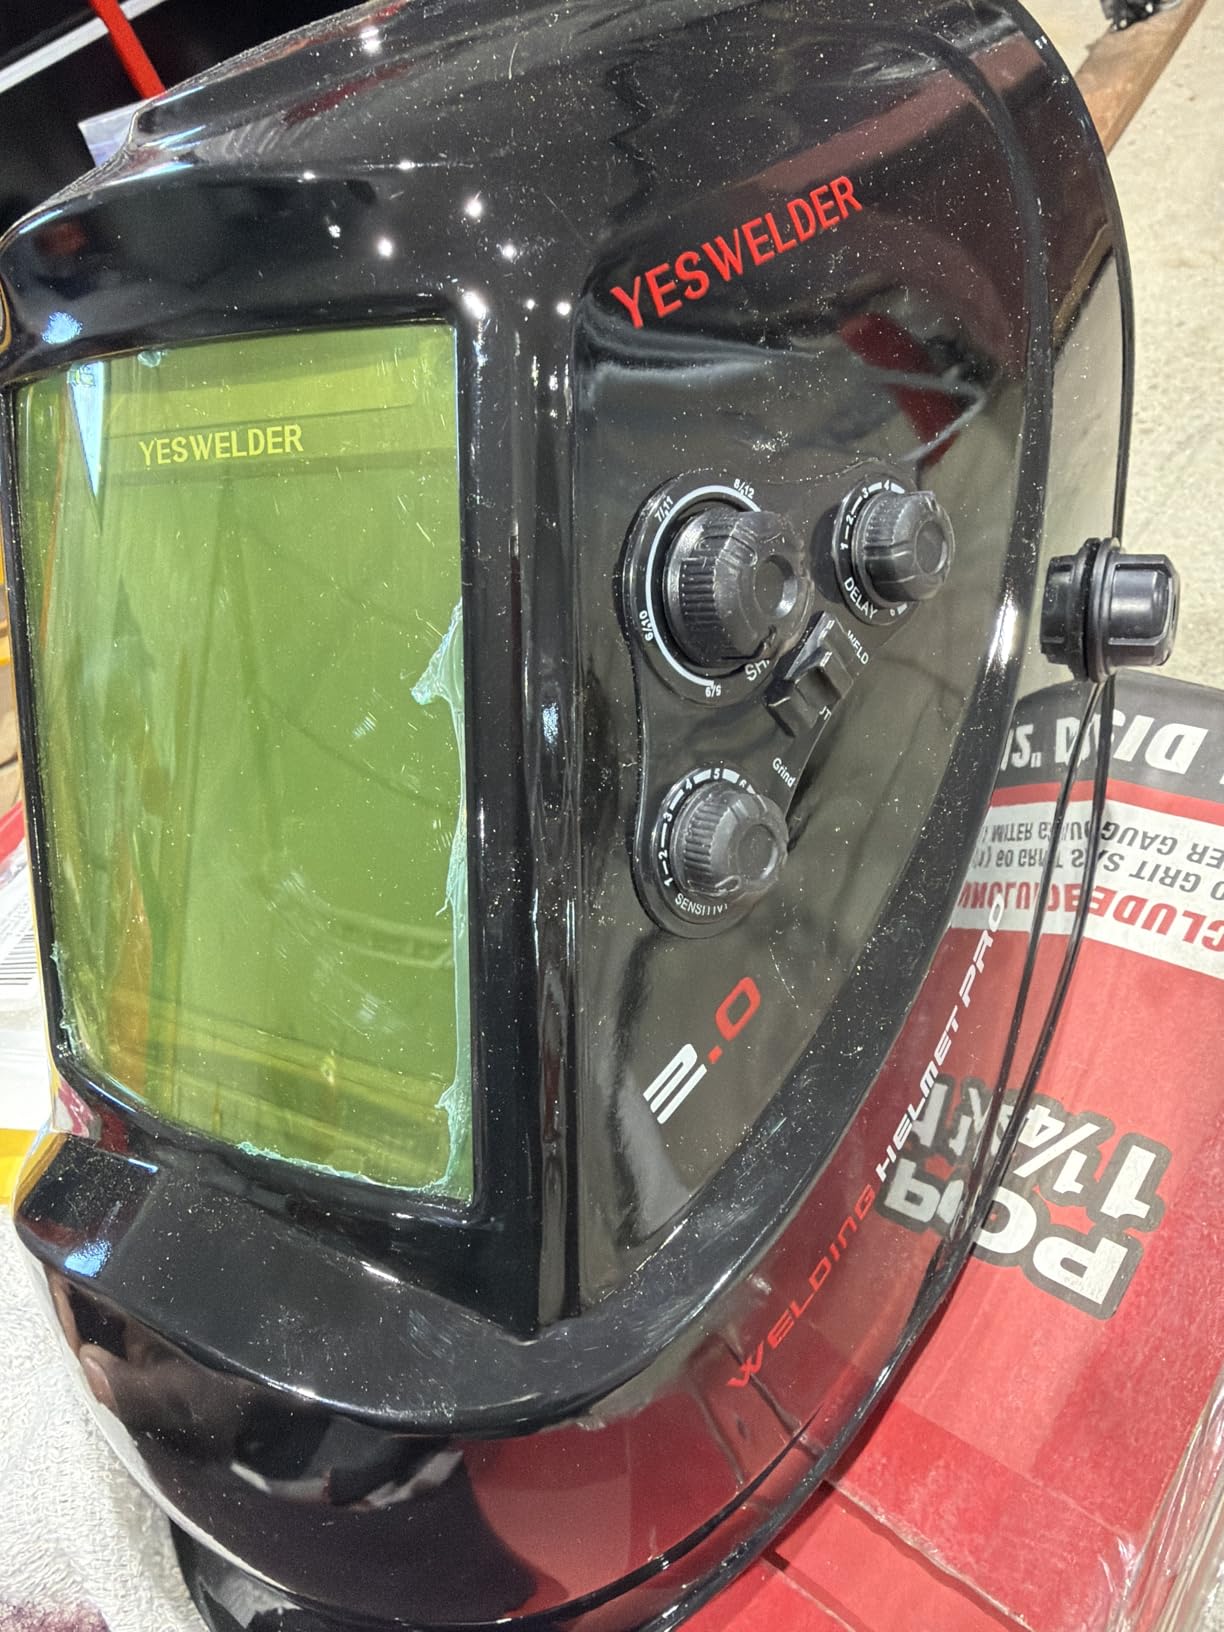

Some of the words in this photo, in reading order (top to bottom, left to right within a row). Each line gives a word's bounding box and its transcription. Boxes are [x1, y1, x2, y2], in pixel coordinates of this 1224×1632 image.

[609, 176, 863, 329] YESWELDER
[139, 424, 304, 466] YESWELDER
[862, 487, 869, 498] 3
[883, 480, 890, 490] 4
[844, 577, 878, 619] DELAY
[685, 778, 693, 790] 4
[713, 768, 721, 780] 5
[772, 757, 796, 788] Grind
[663, 812, 673, 822] 3
[658, 849, 668, 860] 2
[664, 877, 673, 887] 1
[1129, 860, 1202, 893] GRIT
[643, 977, 762, 1125] 2.0
[726, 1183, 876, 1387] WELDING
[876, 1004, 960, 1183] HELMET
[958, 893, 1005, 1008] PRO
